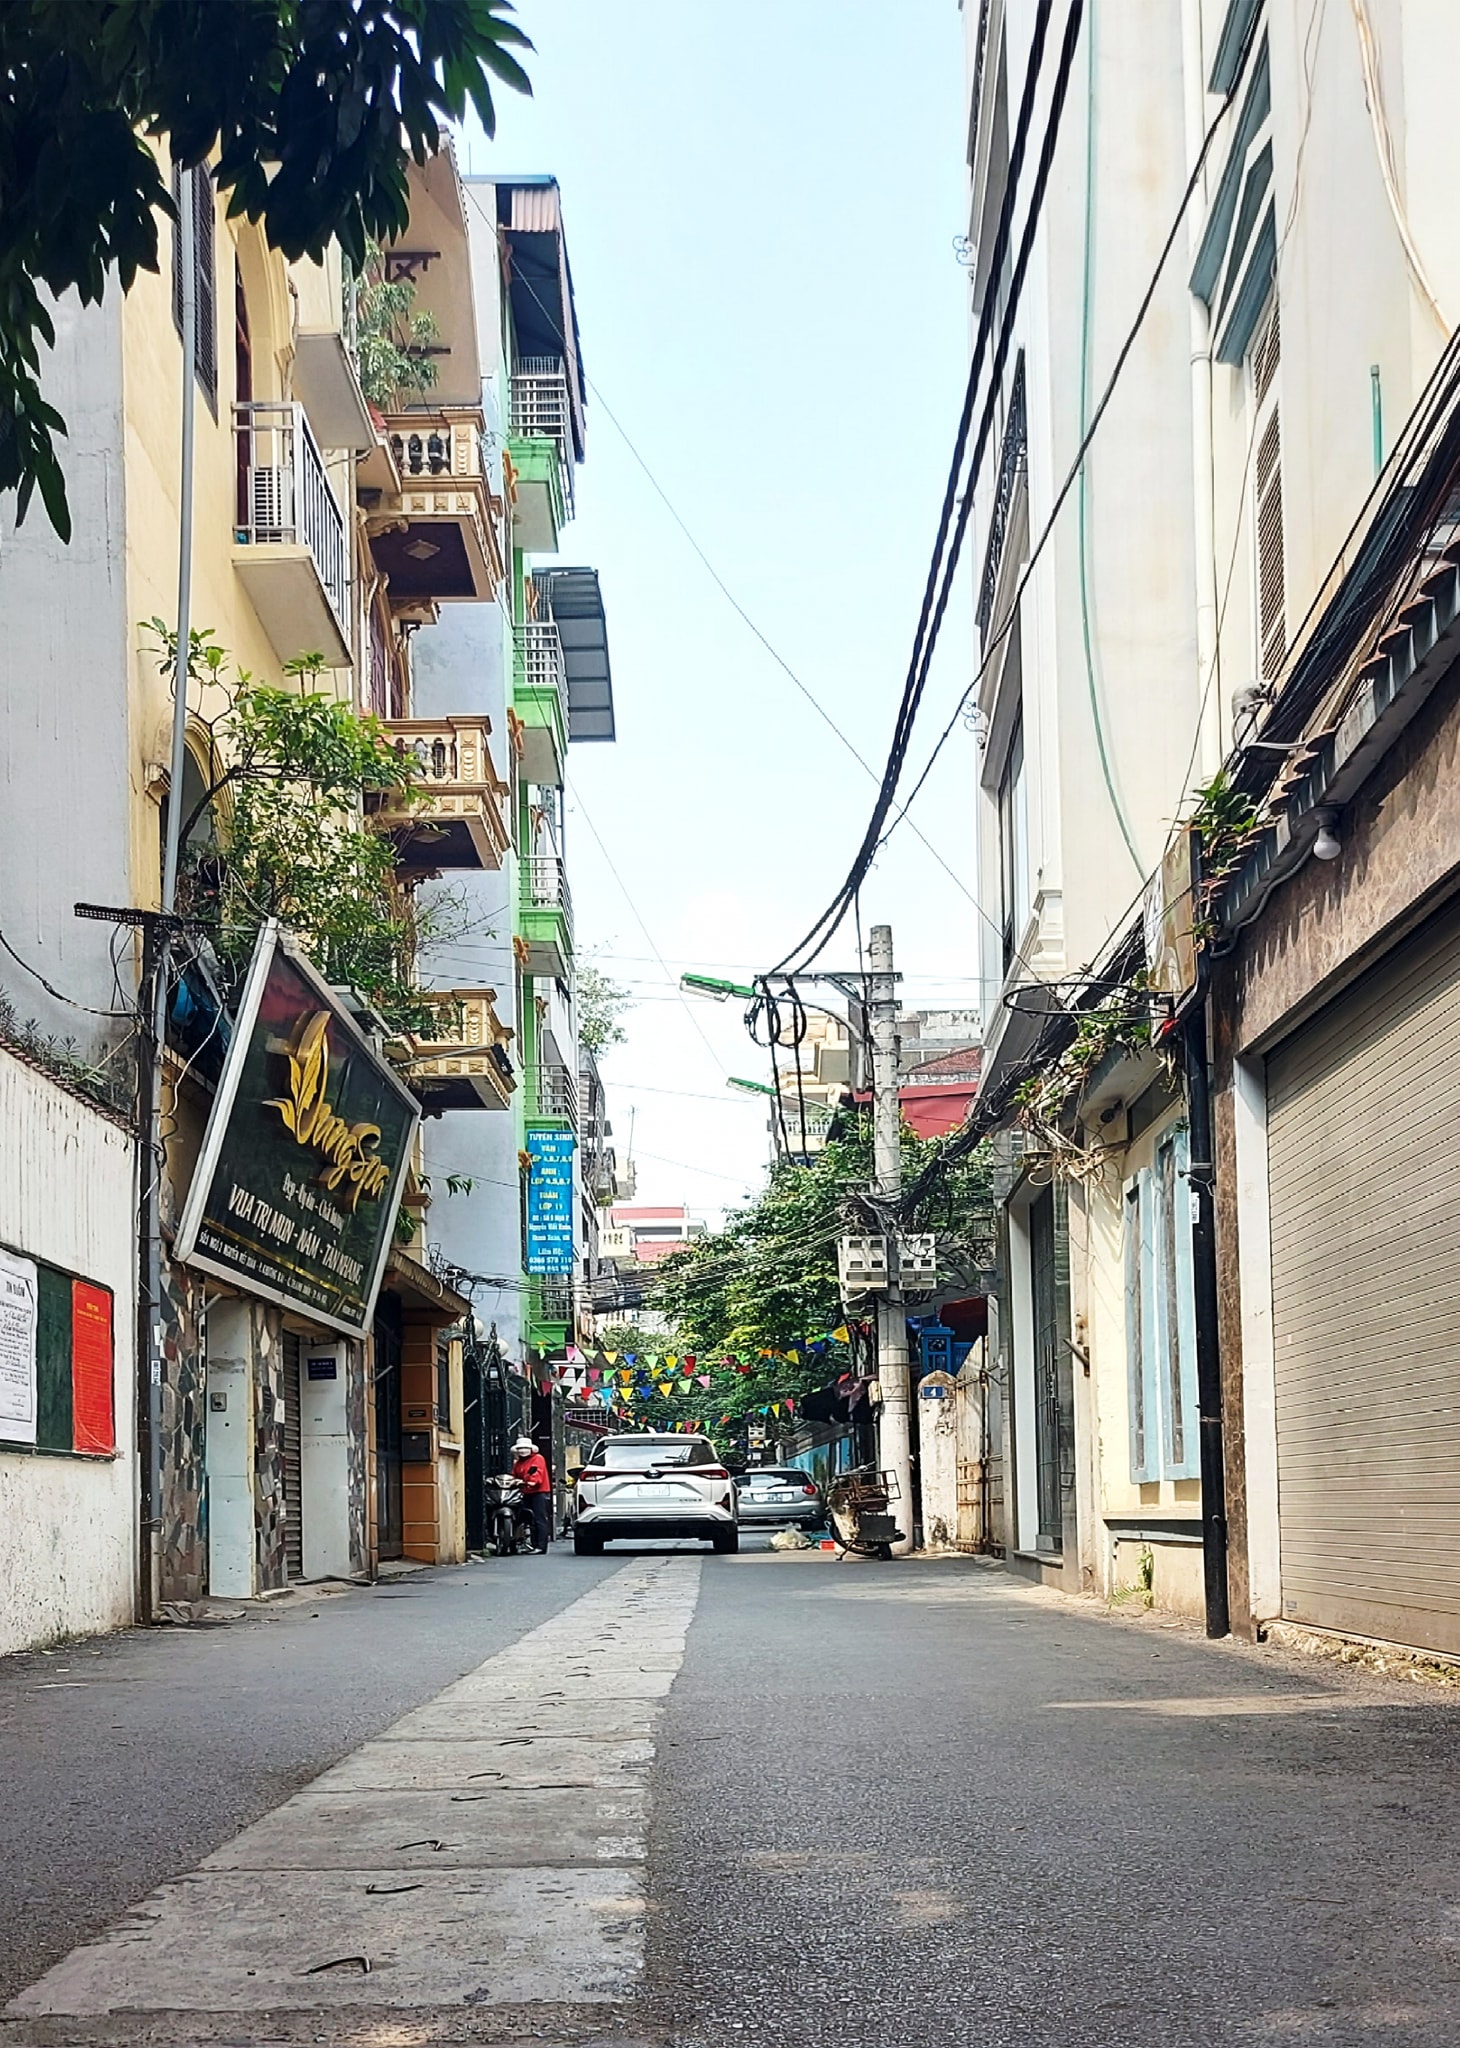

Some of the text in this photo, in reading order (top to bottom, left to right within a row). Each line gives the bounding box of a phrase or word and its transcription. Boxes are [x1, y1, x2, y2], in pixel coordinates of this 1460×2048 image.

[228, 1183, 256, 1221] VUA
[253, 1199, 273, 1239] TRỊ
[268, 1210, 295, 1247] MỤN
